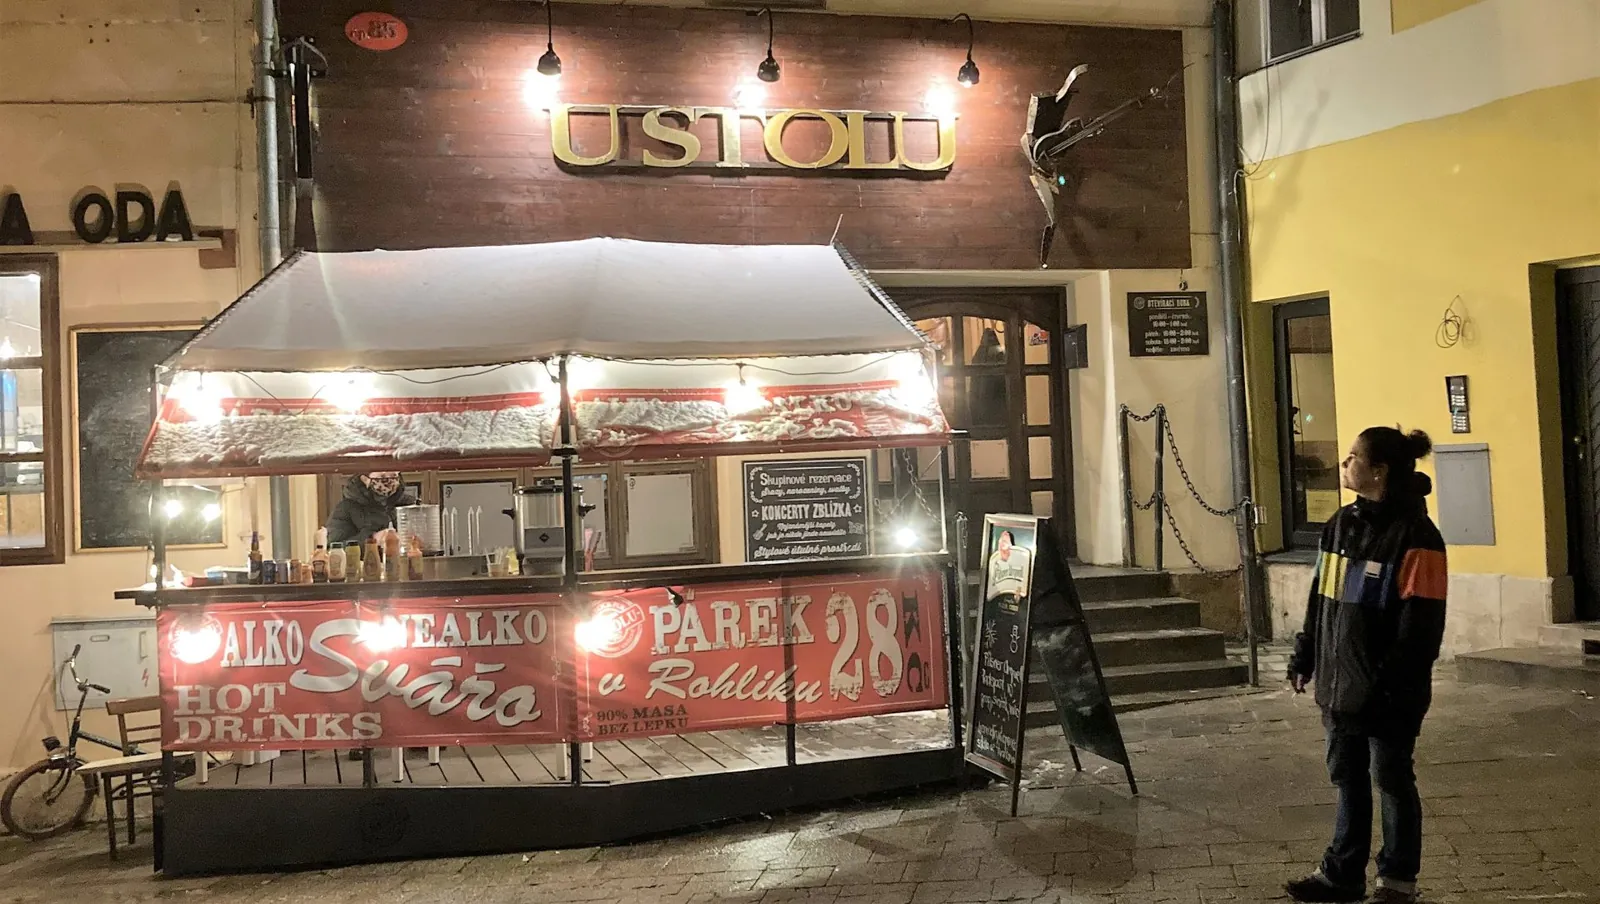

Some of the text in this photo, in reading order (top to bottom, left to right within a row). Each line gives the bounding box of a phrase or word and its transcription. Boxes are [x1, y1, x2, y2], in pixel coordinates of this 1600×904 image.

[74, 190, 193, 243] ODA
[760, 473, 852, 487] Skupinové rezervace
[761, 501, 851, 521] KONCERTY ZBLÍZKA
[754, 546, 790, 558] Stylové
[220, 619, 304, 668] ALKO
[825, 587, 904, 702] 28
[173, 682, 286, 716] HOT
[596, 703, 688, 722] 90% MASA
[173, 712, 383, 745] DRINKS
[597, 717, 689, 736] BEZ LEPKU
